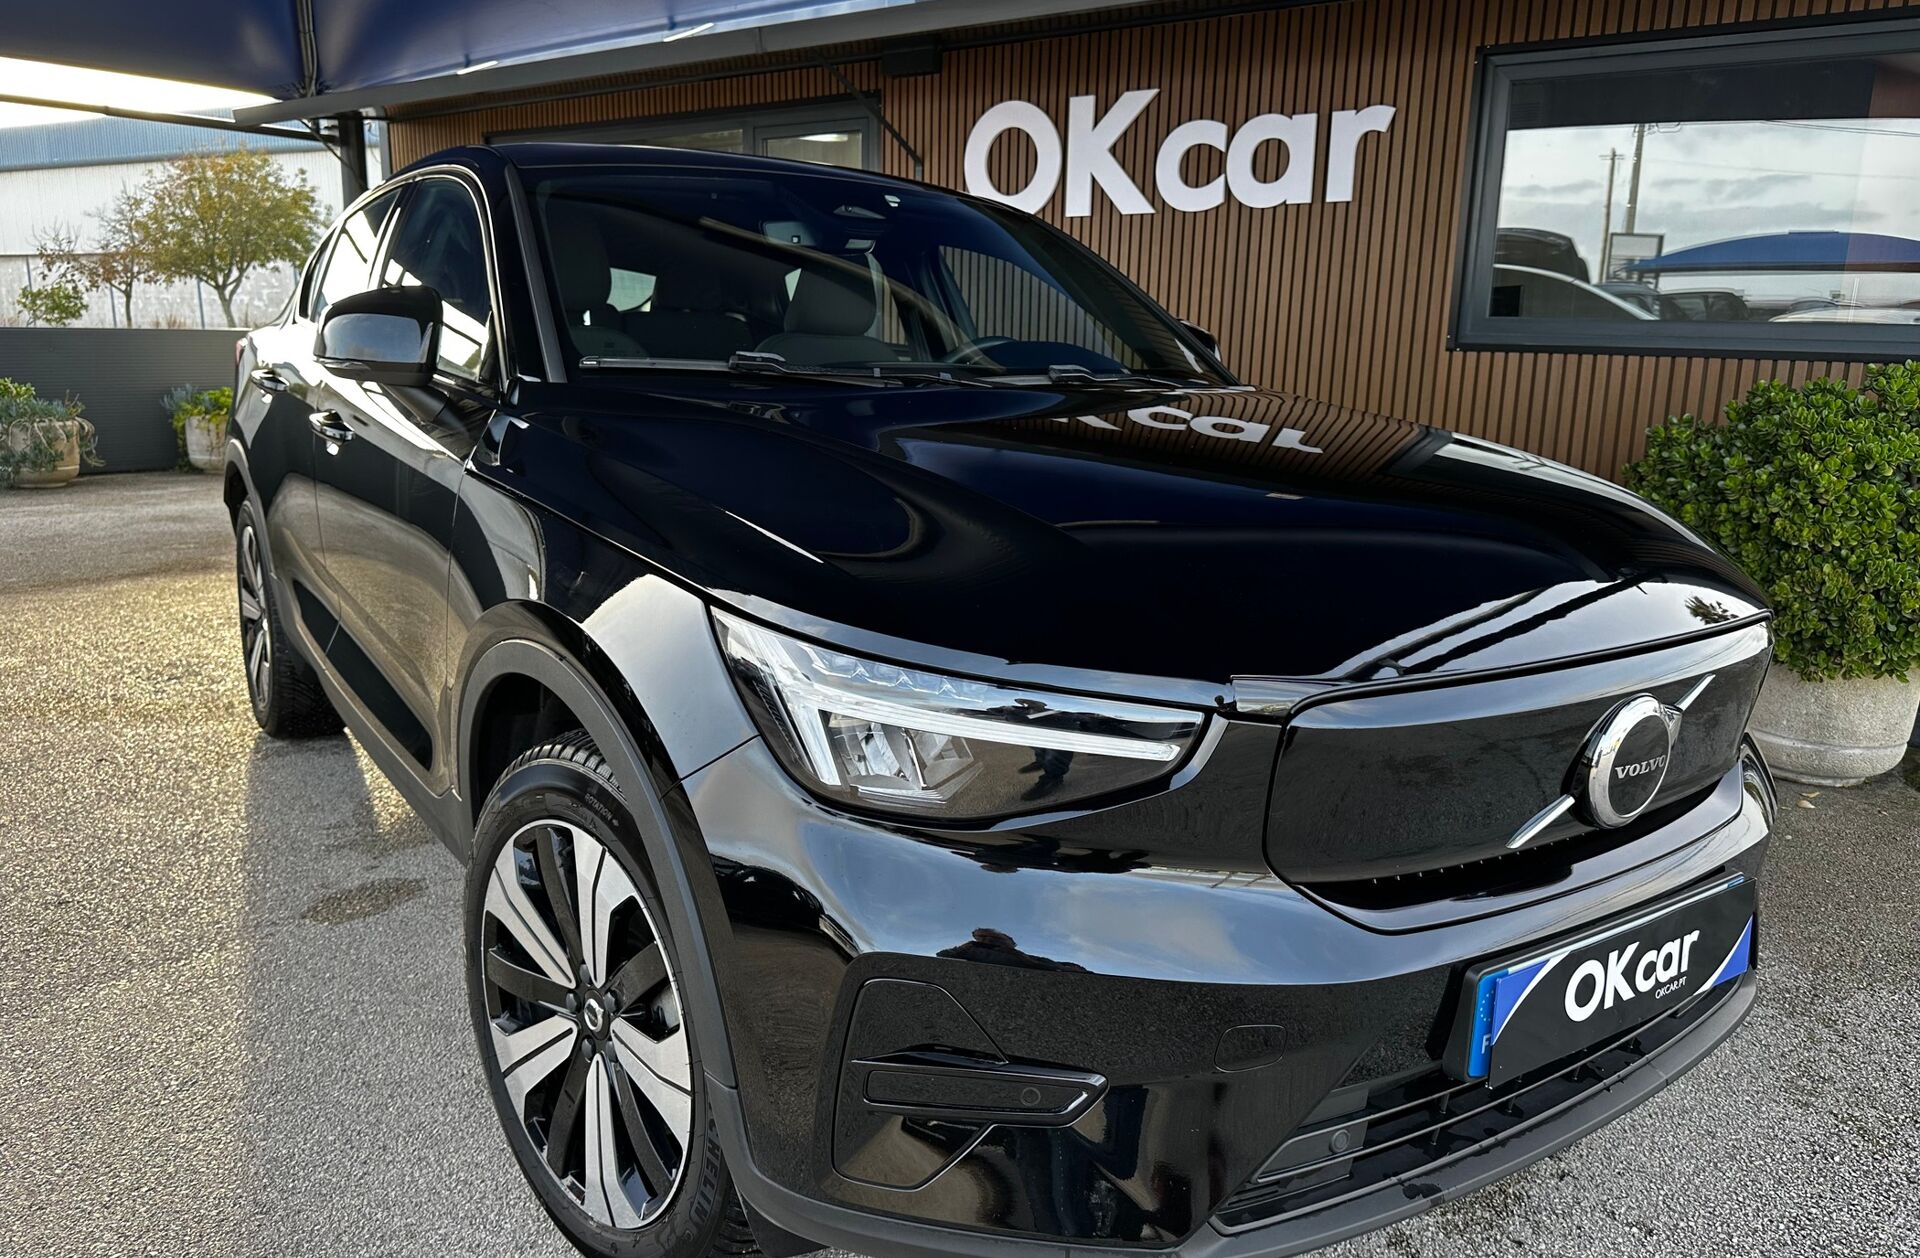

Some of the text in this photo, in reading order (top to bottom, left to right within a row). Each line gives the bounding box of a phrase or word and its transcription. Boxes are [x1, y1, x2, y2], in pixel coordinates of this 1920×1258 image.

[963, 88, 1397, 217] OKcar
[1614, 755, 1666, 779] VOLVO
[1564, 930, 1700, 1022] OKcar
[1655, 976, 1687, 999] OKCAR.PT
